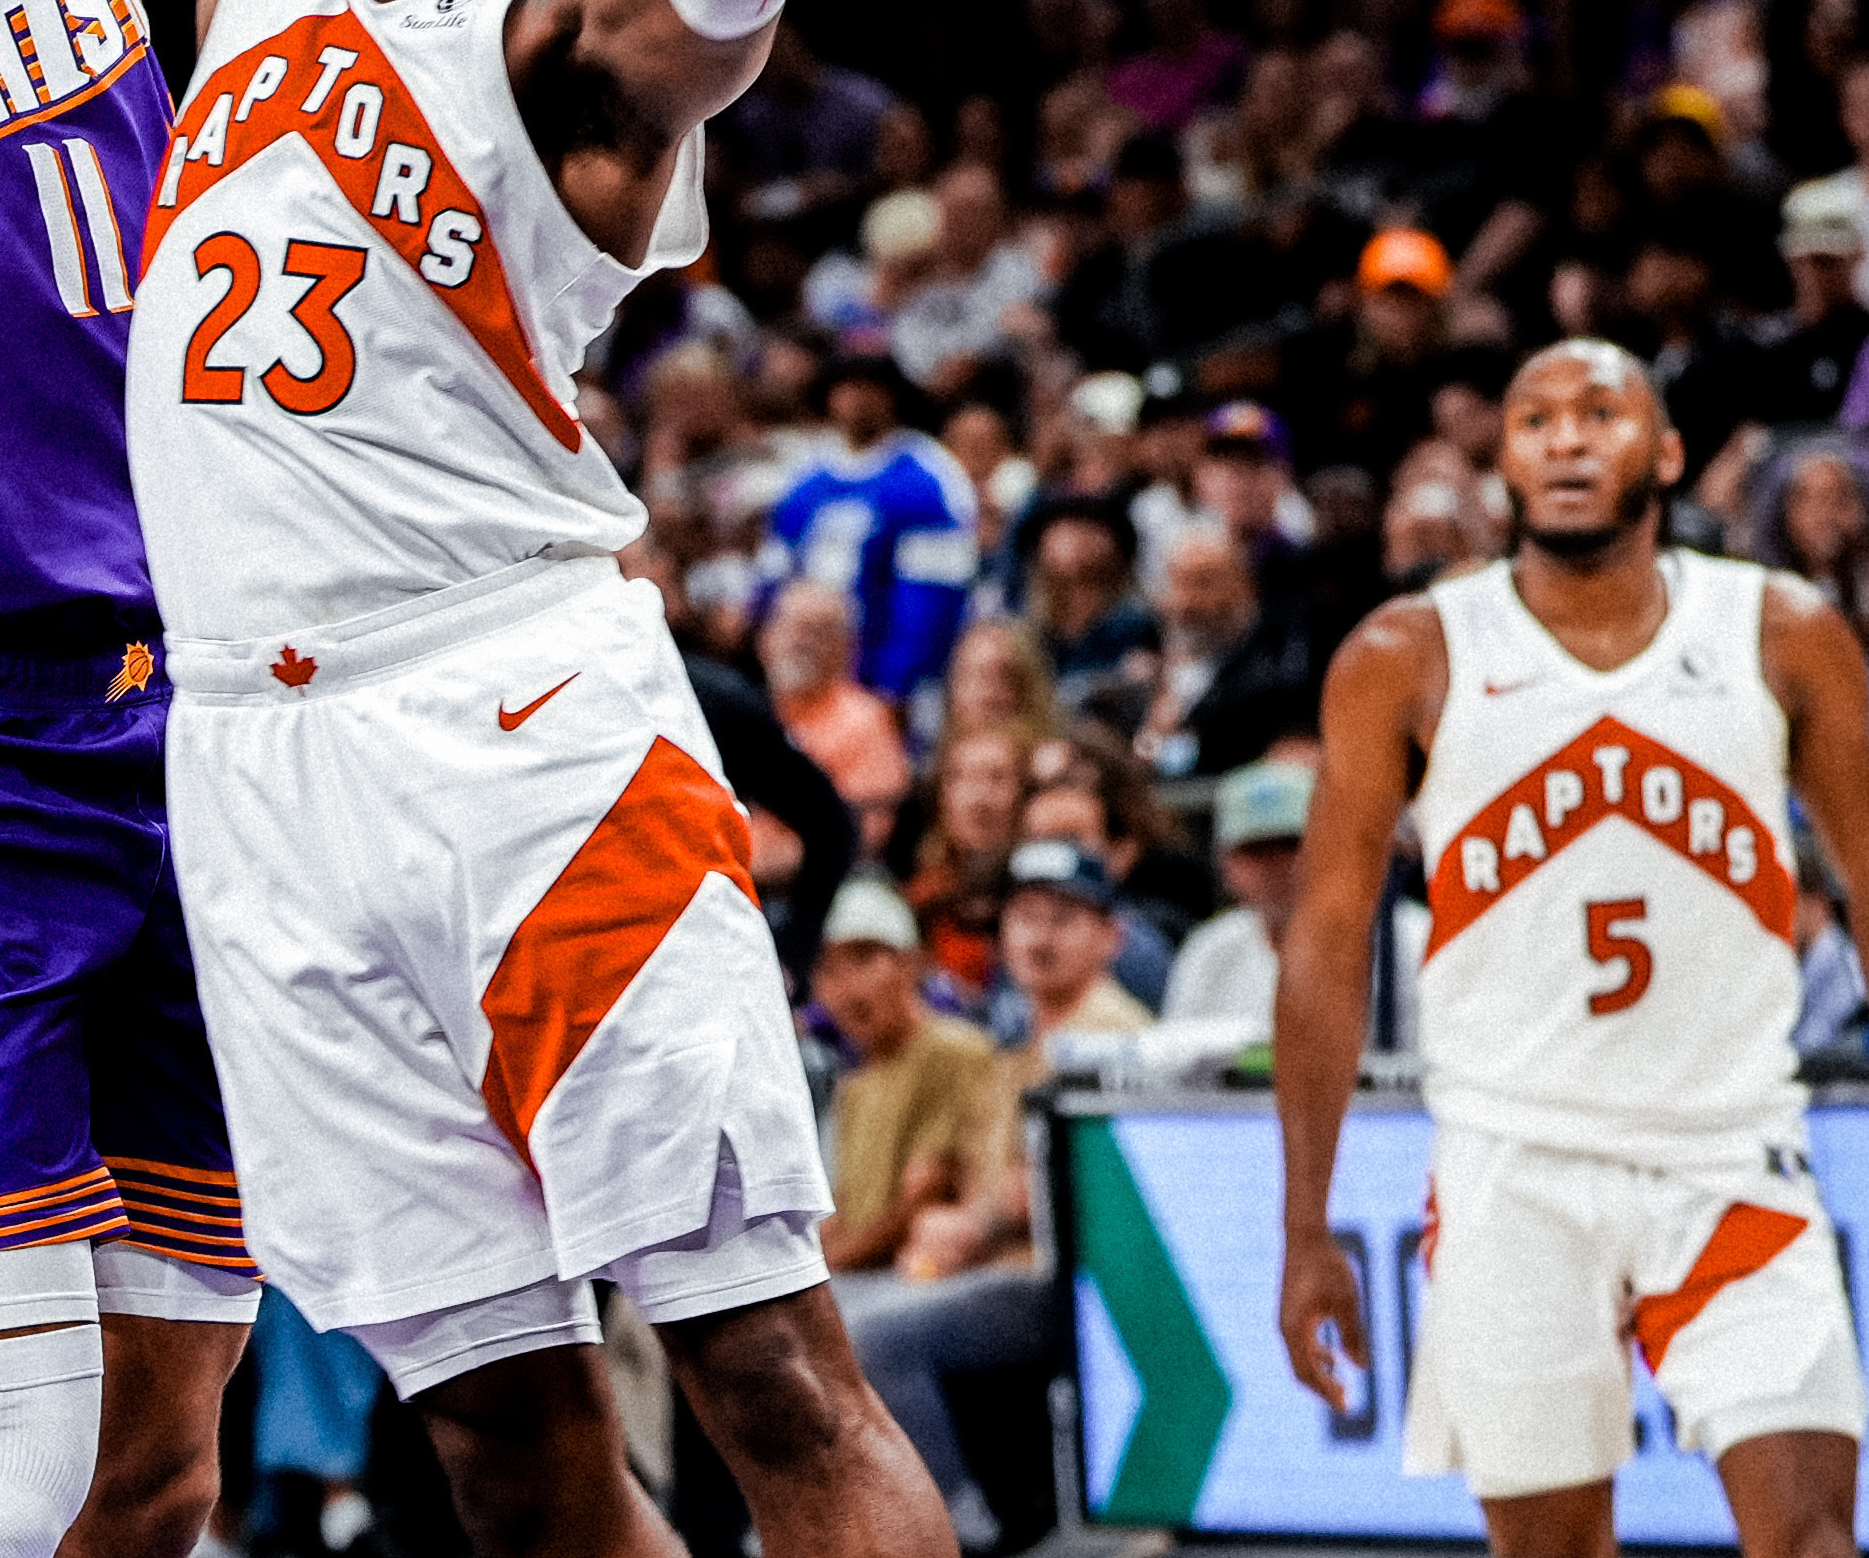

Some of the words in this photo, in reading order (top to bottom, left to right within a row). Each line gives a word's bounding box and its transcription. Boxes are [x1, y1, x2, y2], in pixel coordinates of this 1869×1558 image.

[21, 136, 135, 318] 11
[181, 230, 369, 417] 23
[1460, 745, 1758, 893] RAPTORS
[1585, 897, 1654, 1016] 5
